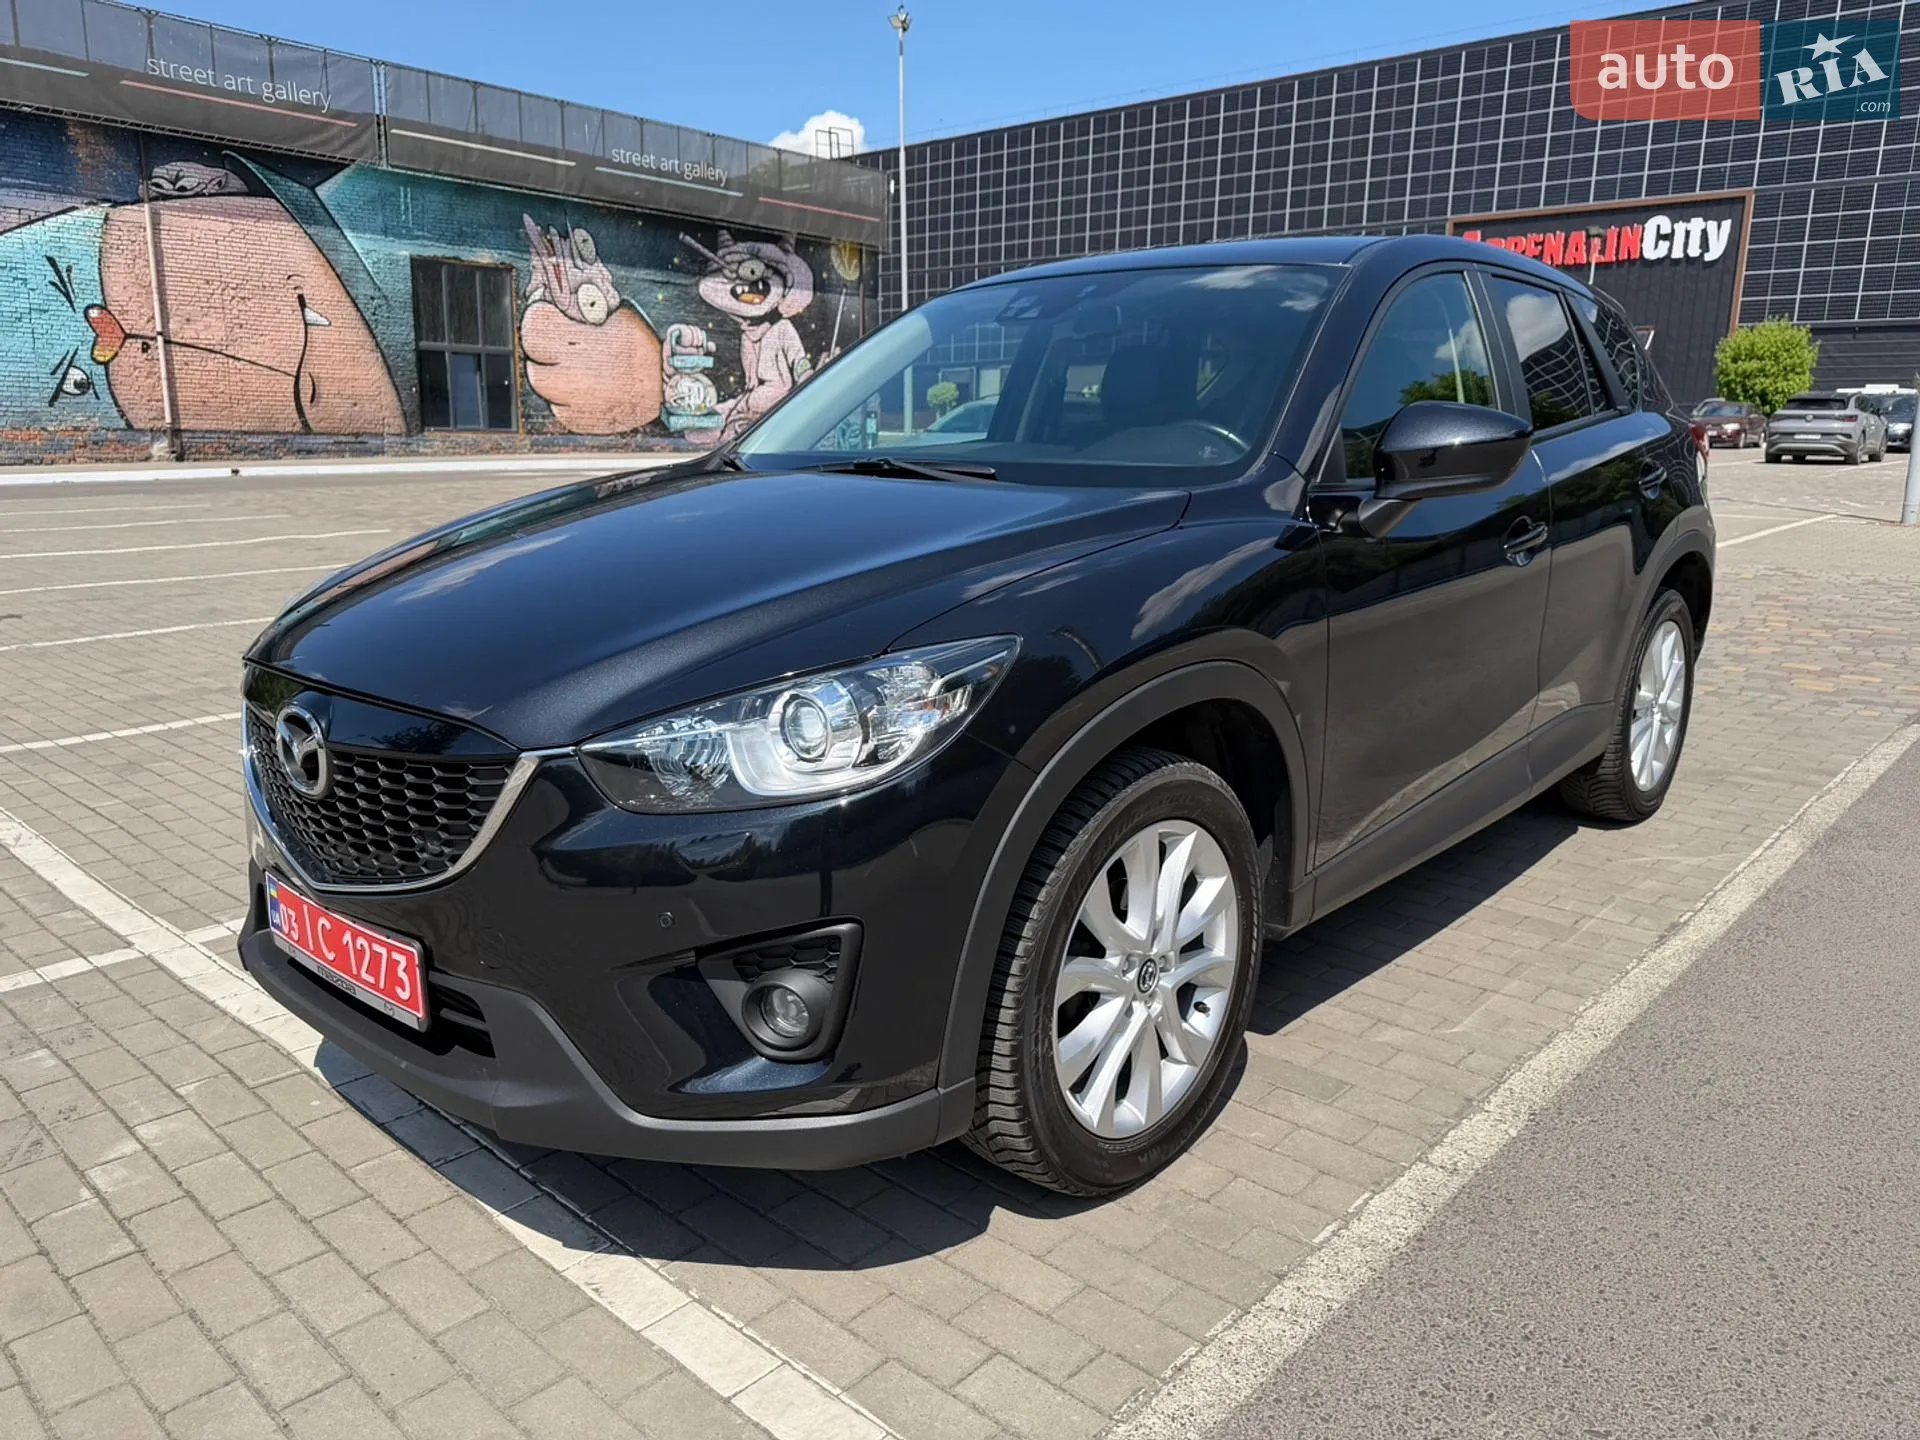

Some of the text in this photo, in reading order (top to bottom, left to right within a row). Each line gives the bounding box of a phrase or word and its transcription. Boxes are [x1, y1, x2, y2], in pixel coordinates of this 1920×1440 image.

[146, 57, 332, 113] street art gallery
[611, 147, 729, 187] street art gallery
[279, 903, 412, 1001] 03 IC 1273
